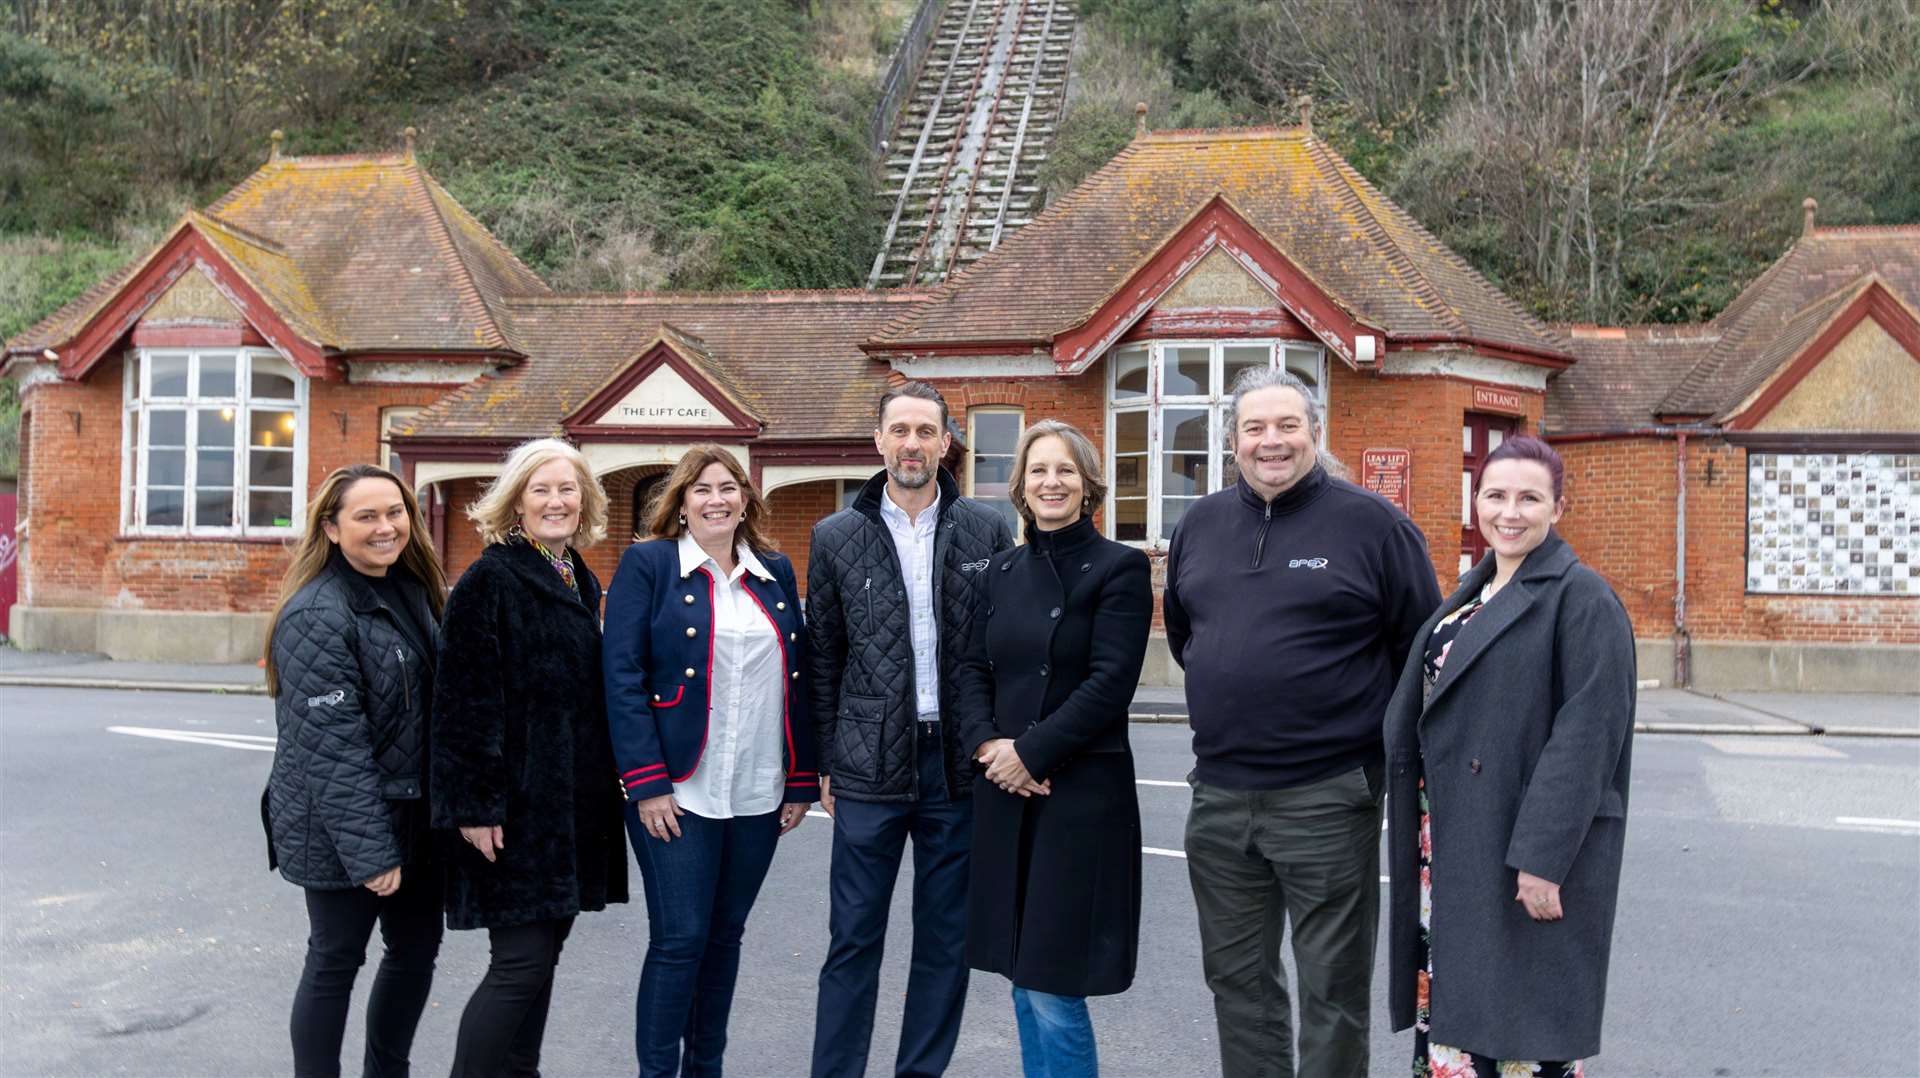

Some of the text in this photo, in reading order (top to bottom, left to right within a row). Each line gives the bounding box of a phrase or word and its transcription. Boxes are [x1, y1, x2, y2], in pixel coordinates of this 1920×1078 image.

[1476, 390, 1519, 408] ENTRANCE
[623, 407, 708, 417] THE LIFT CAFE
[1366, 454, 1406, 463] LEAS LIFT
